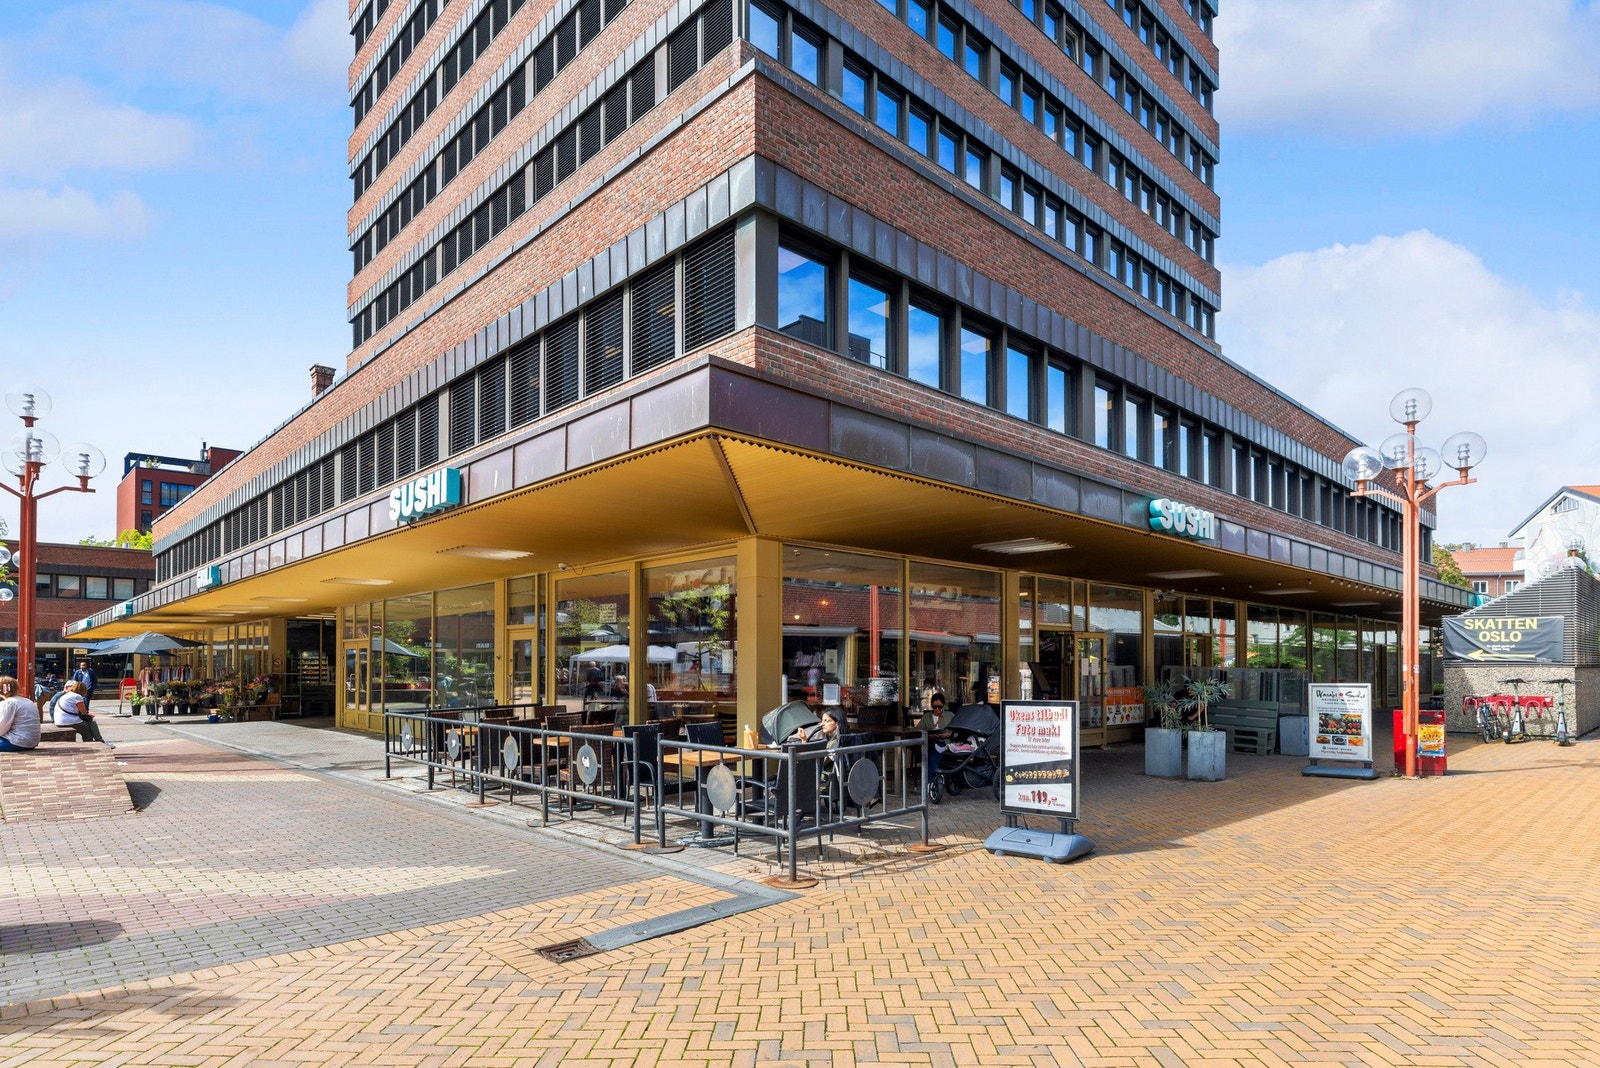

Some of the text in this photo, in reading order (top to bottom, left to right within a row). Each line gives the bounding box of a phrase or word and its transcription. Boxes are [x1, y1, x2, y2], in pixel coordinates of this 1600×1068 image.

[389, 467, 447, 521] SUSHI
[1158, 498, 1215, 540] SUSHI
[1464, 618, 1538, 630] SKATTEN
[1478, 631, 1522, 642] OSLO
[1345, 690, 1366, 699] Sushi
